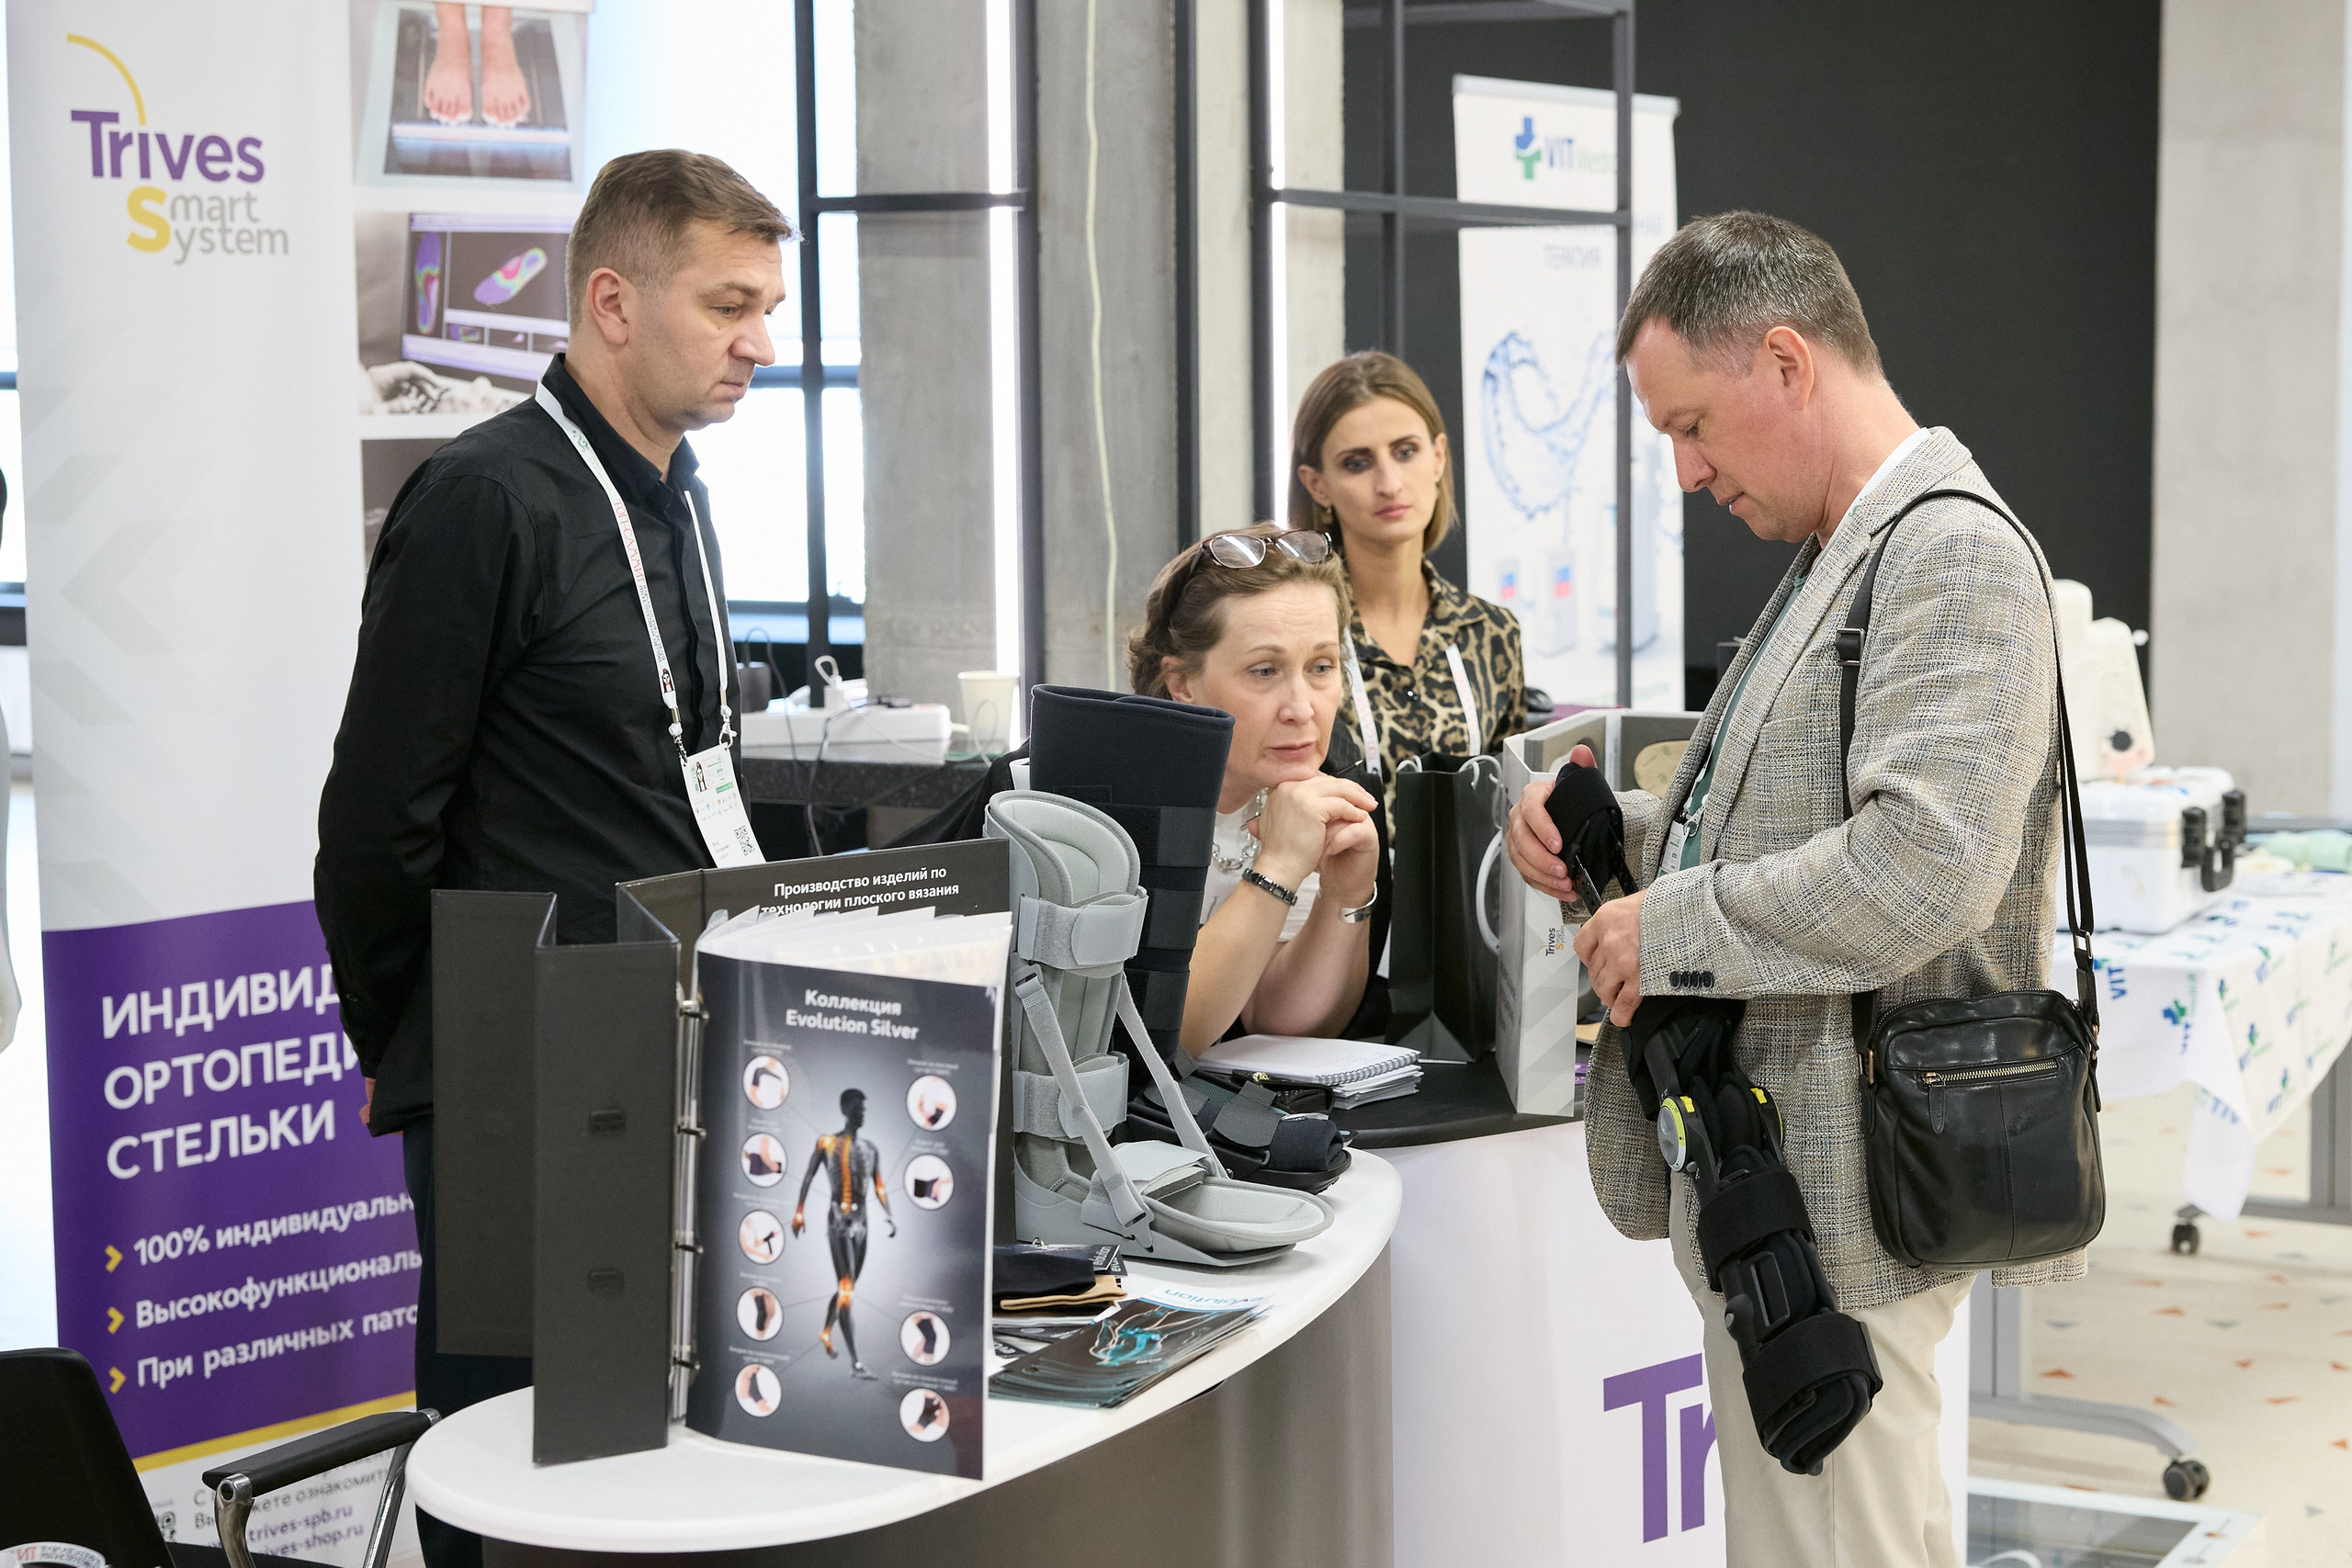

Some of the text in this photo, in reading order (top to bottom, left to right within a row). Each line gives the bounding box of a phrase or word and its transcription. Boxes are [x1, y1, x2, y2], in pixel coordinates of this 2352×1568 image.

[71, 109, 265, 184] Trives
[614, 499, 646, 583] ТОП-САММИТ
[774, 866, 947, 898] Производство изделий по
[843, 890, 906, 908] плоского
[909, 885, 959, 899] вязания
[805, 988, 902, 1016] Коллекция
[786, 1010, 919, 1040] Evolution Silver
[106, 1099, 336, 1179] СТЕЛЬКИ
[133, 1224, 210, 1267] 100%
[137, 1352, 193, 1389] При
[203, 1318, 355, 1378] различных
